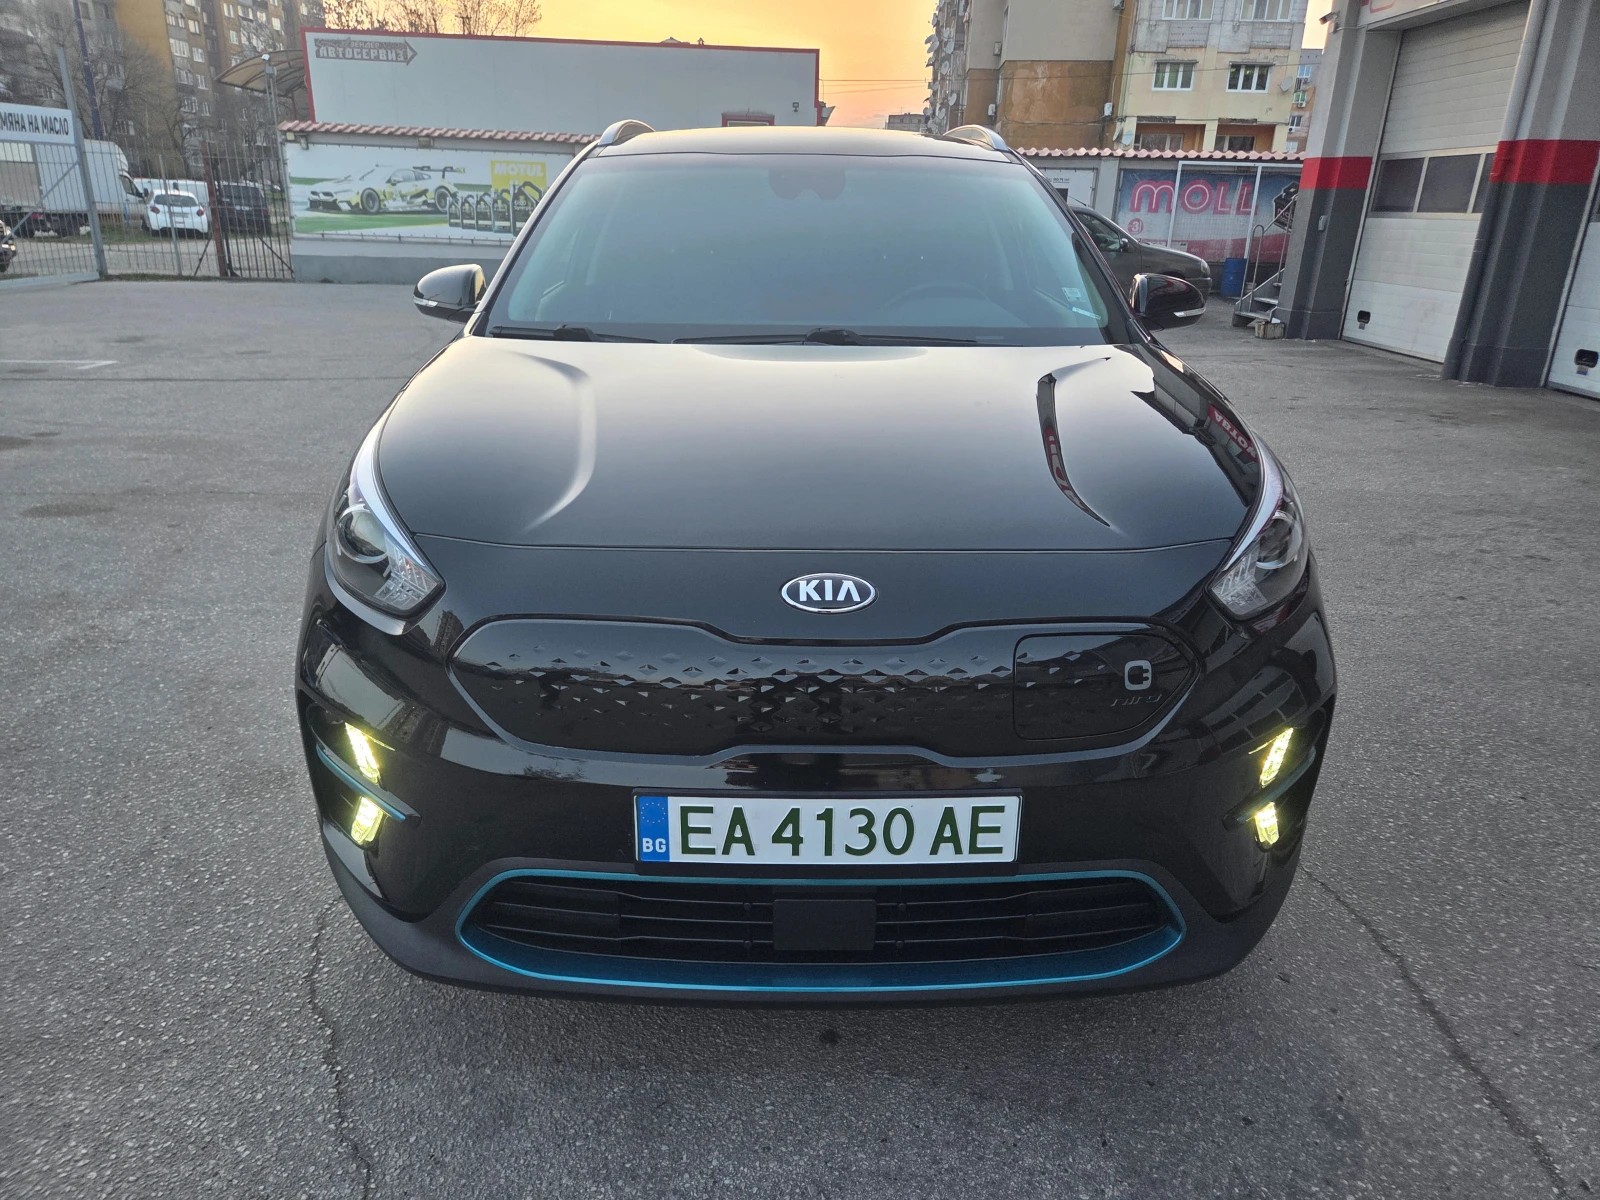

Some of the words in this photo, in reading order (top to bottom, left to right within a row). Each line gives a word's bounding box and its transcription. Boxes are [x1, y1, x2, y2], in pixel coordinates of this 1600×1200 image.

[319, 45, 406, 61] АВТОСЕРВИЗ
[27, 113, 40, 134] НА
[41, 115, 69, 136] МАСЛО
[493, 162, 544, 177] MOTUL
[1130, 179, 1259, 215] MOLL
[798, 579, 861, 602] KIA
[642, 837, 667, 853] BG
[679, 805, 756, 856] EA
[771, 807, 915, 857] 4130
[929, 805, 1006, 856] AE
